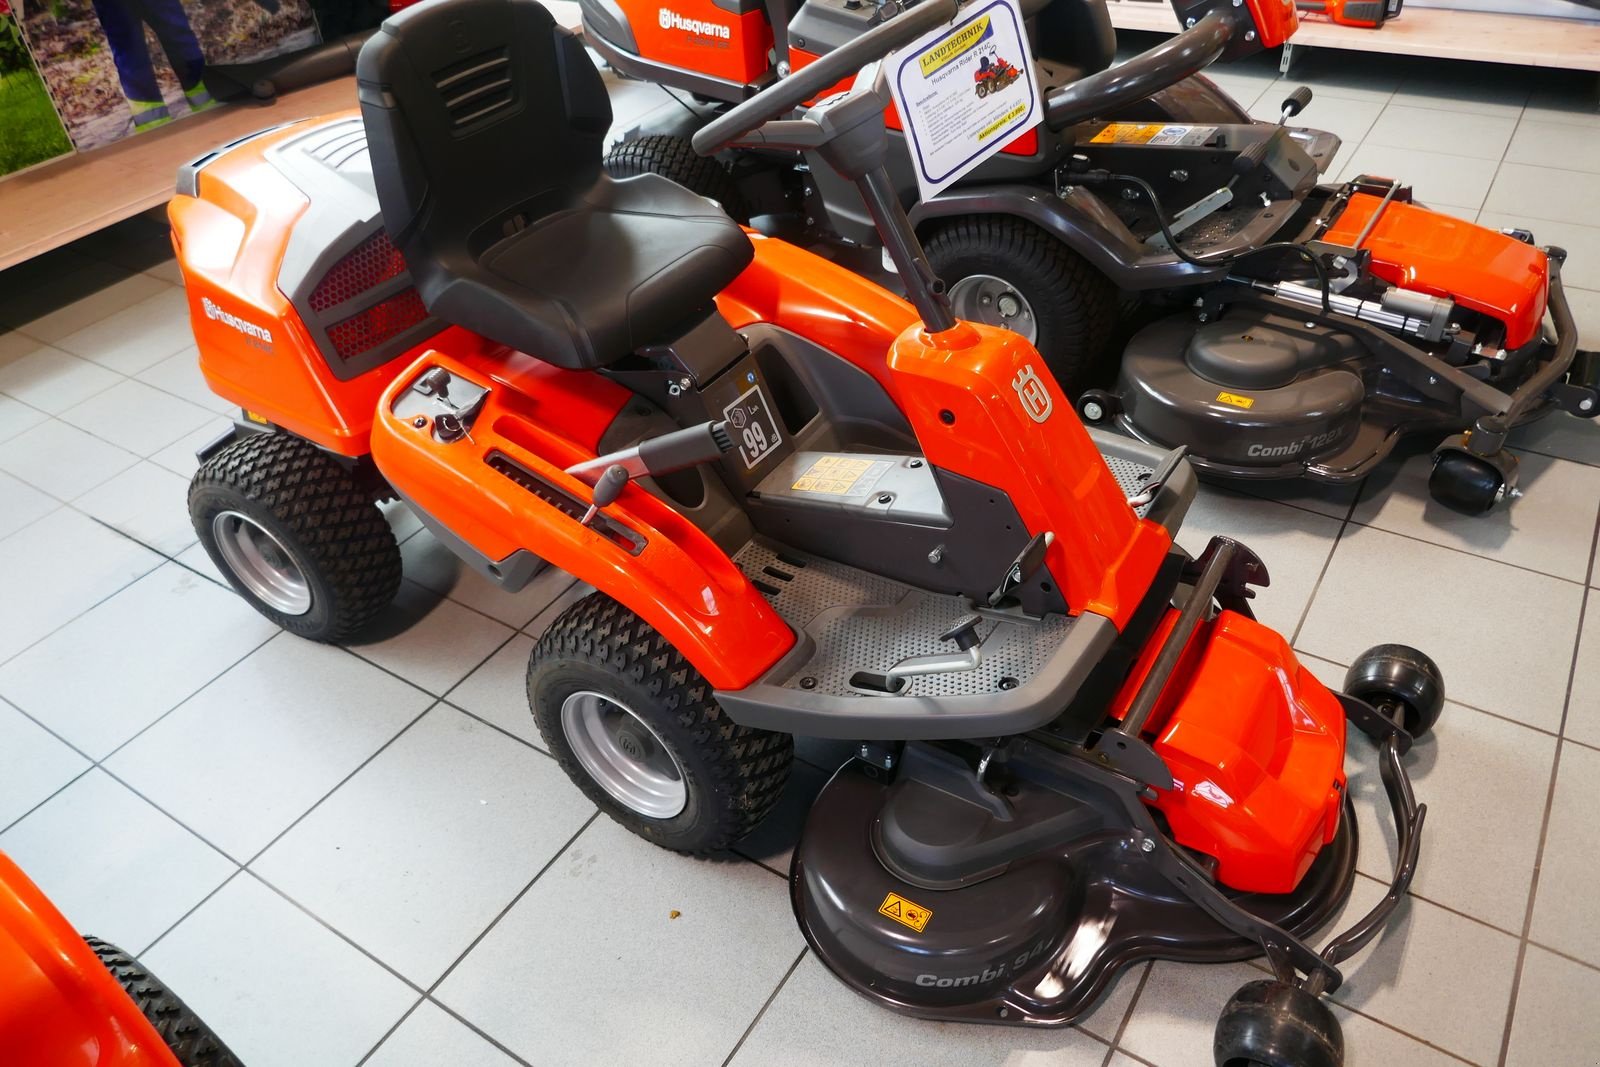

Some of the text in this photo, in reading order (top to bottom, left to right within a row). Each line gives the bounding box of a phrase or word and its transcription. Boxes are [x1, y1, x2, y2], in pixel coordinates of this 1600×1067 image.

[671, 12, 730, 39] Husqvarna
[921, 22, 984, 67] LANDTECHNIK
[931, 63, 960, 85] Husqvarna
[959, 55, 973, 67] Rider
[213, 303, 273, 343] Husqvarna
[742, 421, 768, 458] 99
[1247, 440, 1305, 457] Combi
[915, 964, 1006, 988] Combi
